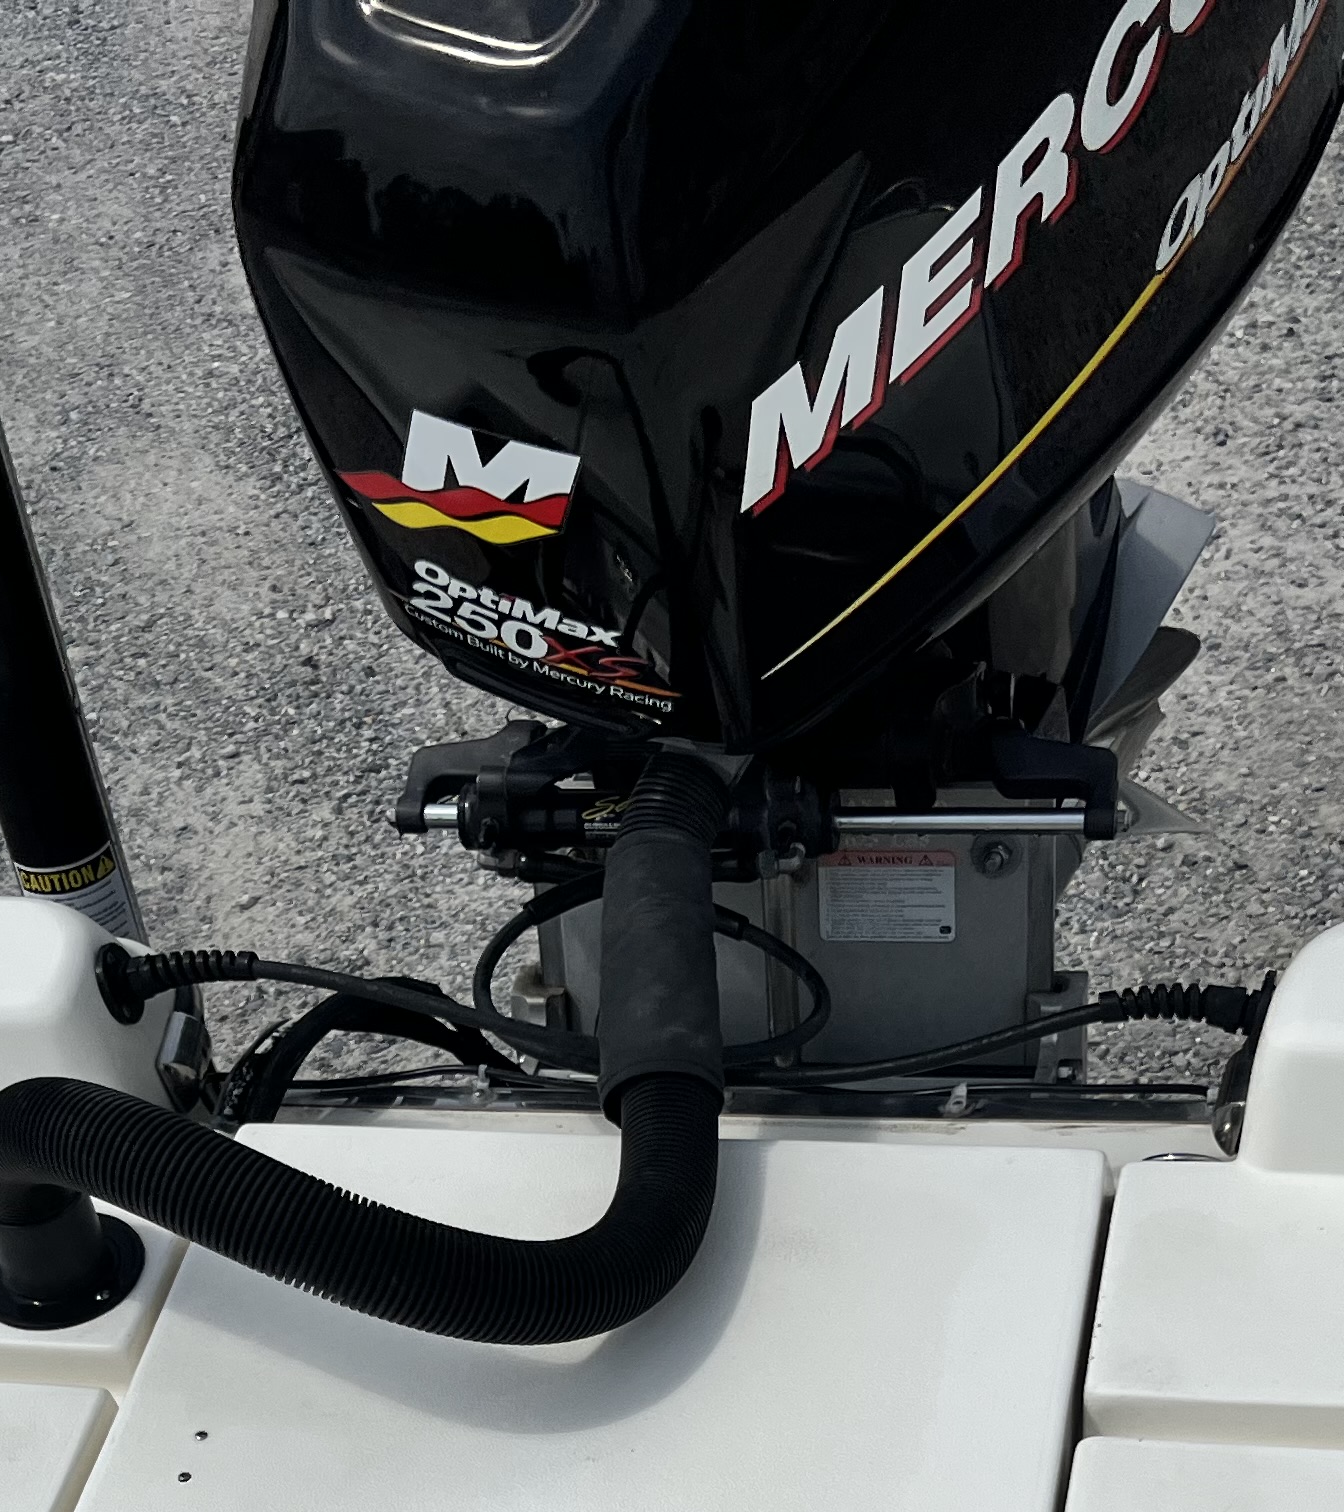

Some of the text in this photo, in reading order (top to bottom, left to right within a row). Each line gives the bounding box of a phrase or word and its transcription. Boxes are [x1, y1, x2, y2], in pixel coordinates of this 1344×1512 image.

[414, 560, 623, 648] OptiMax
[404, 604, 674, 712] Custom Built by Mercury Racing
[20, 865, 96, 893] CAUTION
[856, 855, 914, 865] WARNING
